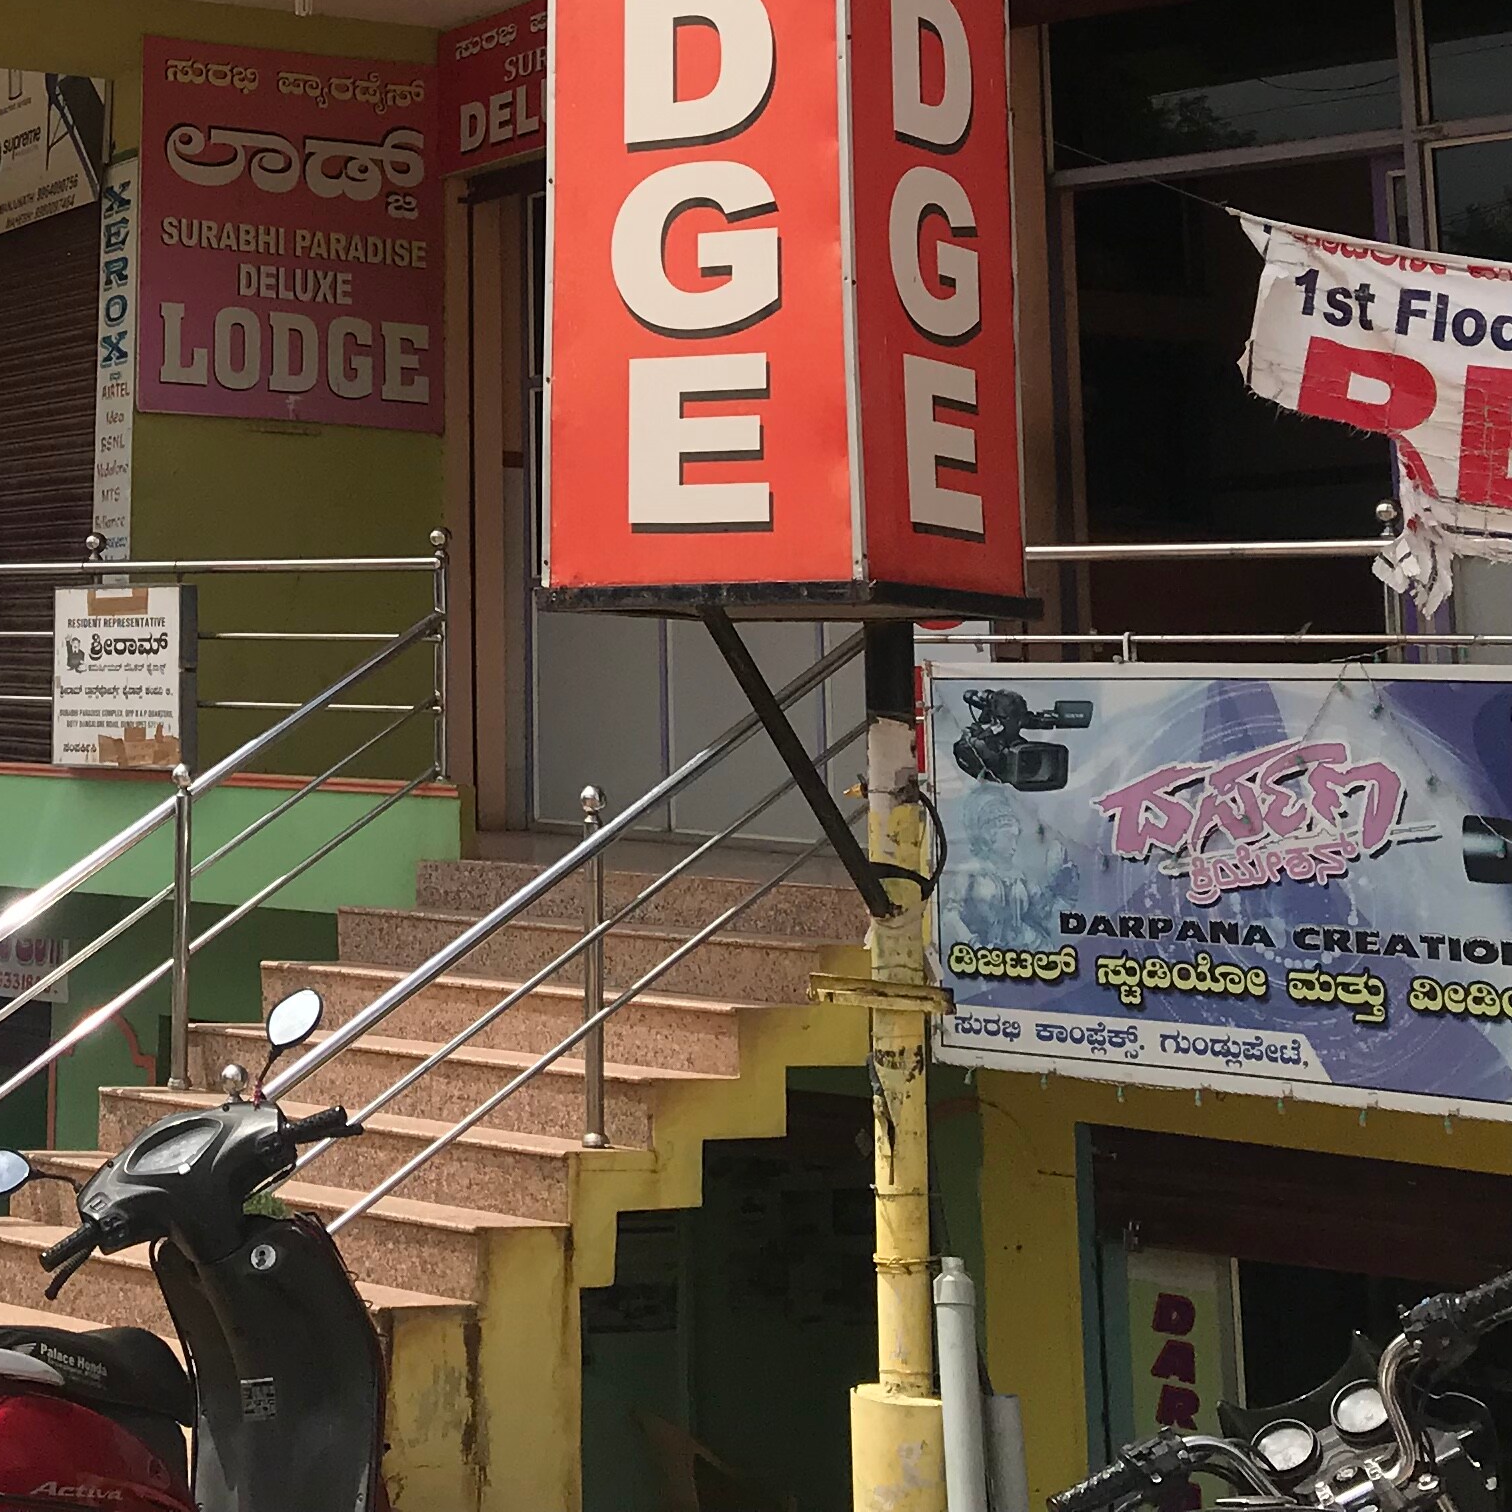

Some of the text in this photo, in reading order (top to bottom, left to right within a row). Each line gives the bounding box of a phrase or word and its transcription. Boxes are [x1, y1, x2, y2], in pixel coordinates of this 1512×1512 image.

[165, 58, 260, 94] ಸುರಭಿ
[2, 126, 42, 160] supreme
[160, 216, 428, 270] SURABHI PARADISE
[100, 180, 133, 369] XEROX
[238, 263, 354, 306] DELUXE
[1295, 268, 1375, 331] 1st
[159, 301, 430, 405] LODGE
[101, 382, 131, 400] AIRTEL
[100, 436, 126, 453] BSNL
[101, 488, 121, 502] MTS
[67, 616, 166, 629] RESIDENT REPRESENTATIVE
[88, 631, 169, 661] ಶ್ರೀರಾಮ್
[1059, 910, 1276, 949] DARPANA
[945, 941, 1079, 982] ಡಿಜಿಟಲ್
[1287, 963, 1387, 1022] ಮತ್ತು
[953, 1014, 1022, 1041] ಸುರಭಿ
[40, 1342, 75, 1366] Palace
[77, 1355, 108, 1377] Honda
[30, 1480, 124, 1501] Activa
